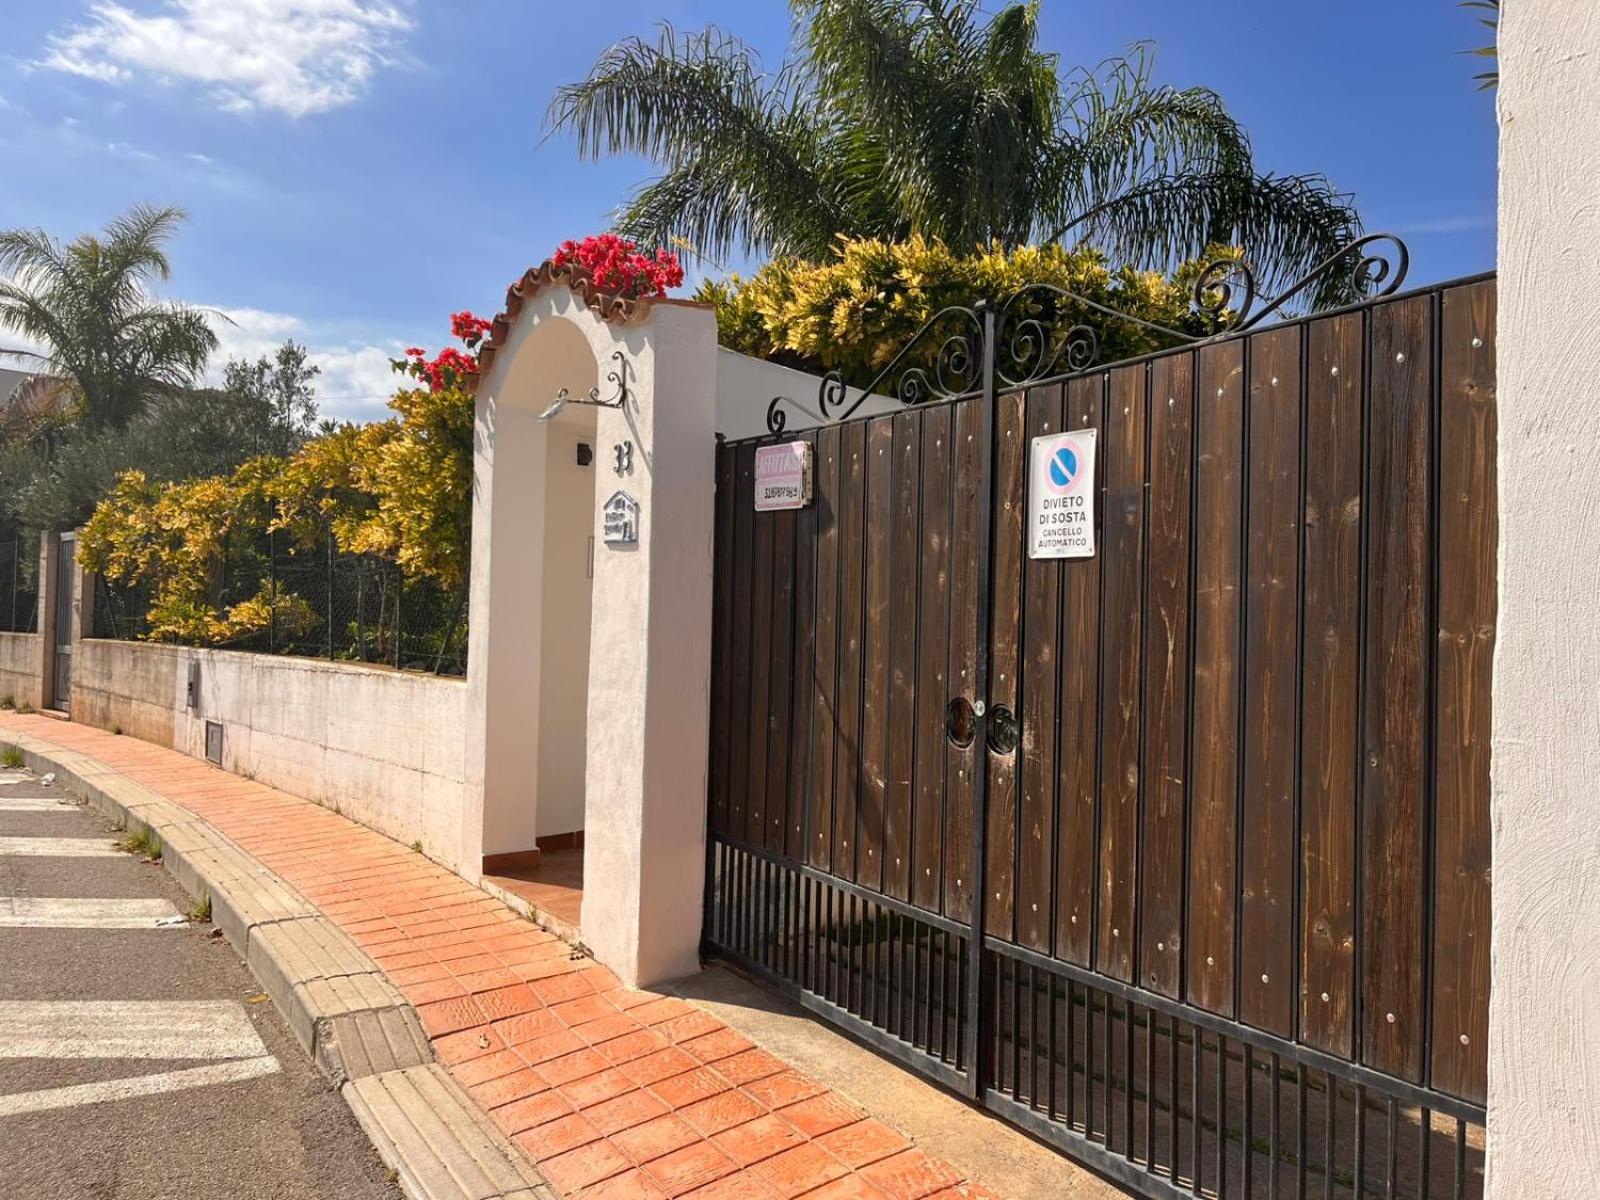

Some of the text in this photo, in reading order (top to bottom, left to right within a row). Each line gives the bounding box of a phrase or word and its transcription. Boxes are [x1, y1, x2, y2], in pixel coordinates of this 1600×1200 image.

[1043, 496, 1083, 509] DIVIETO
[1039, 512, 1086, 525] DI SOSTA
[1042, 527, 1082, 537] CANCELLO
[1038, 538, 1087, 548] AUTOMATICO
